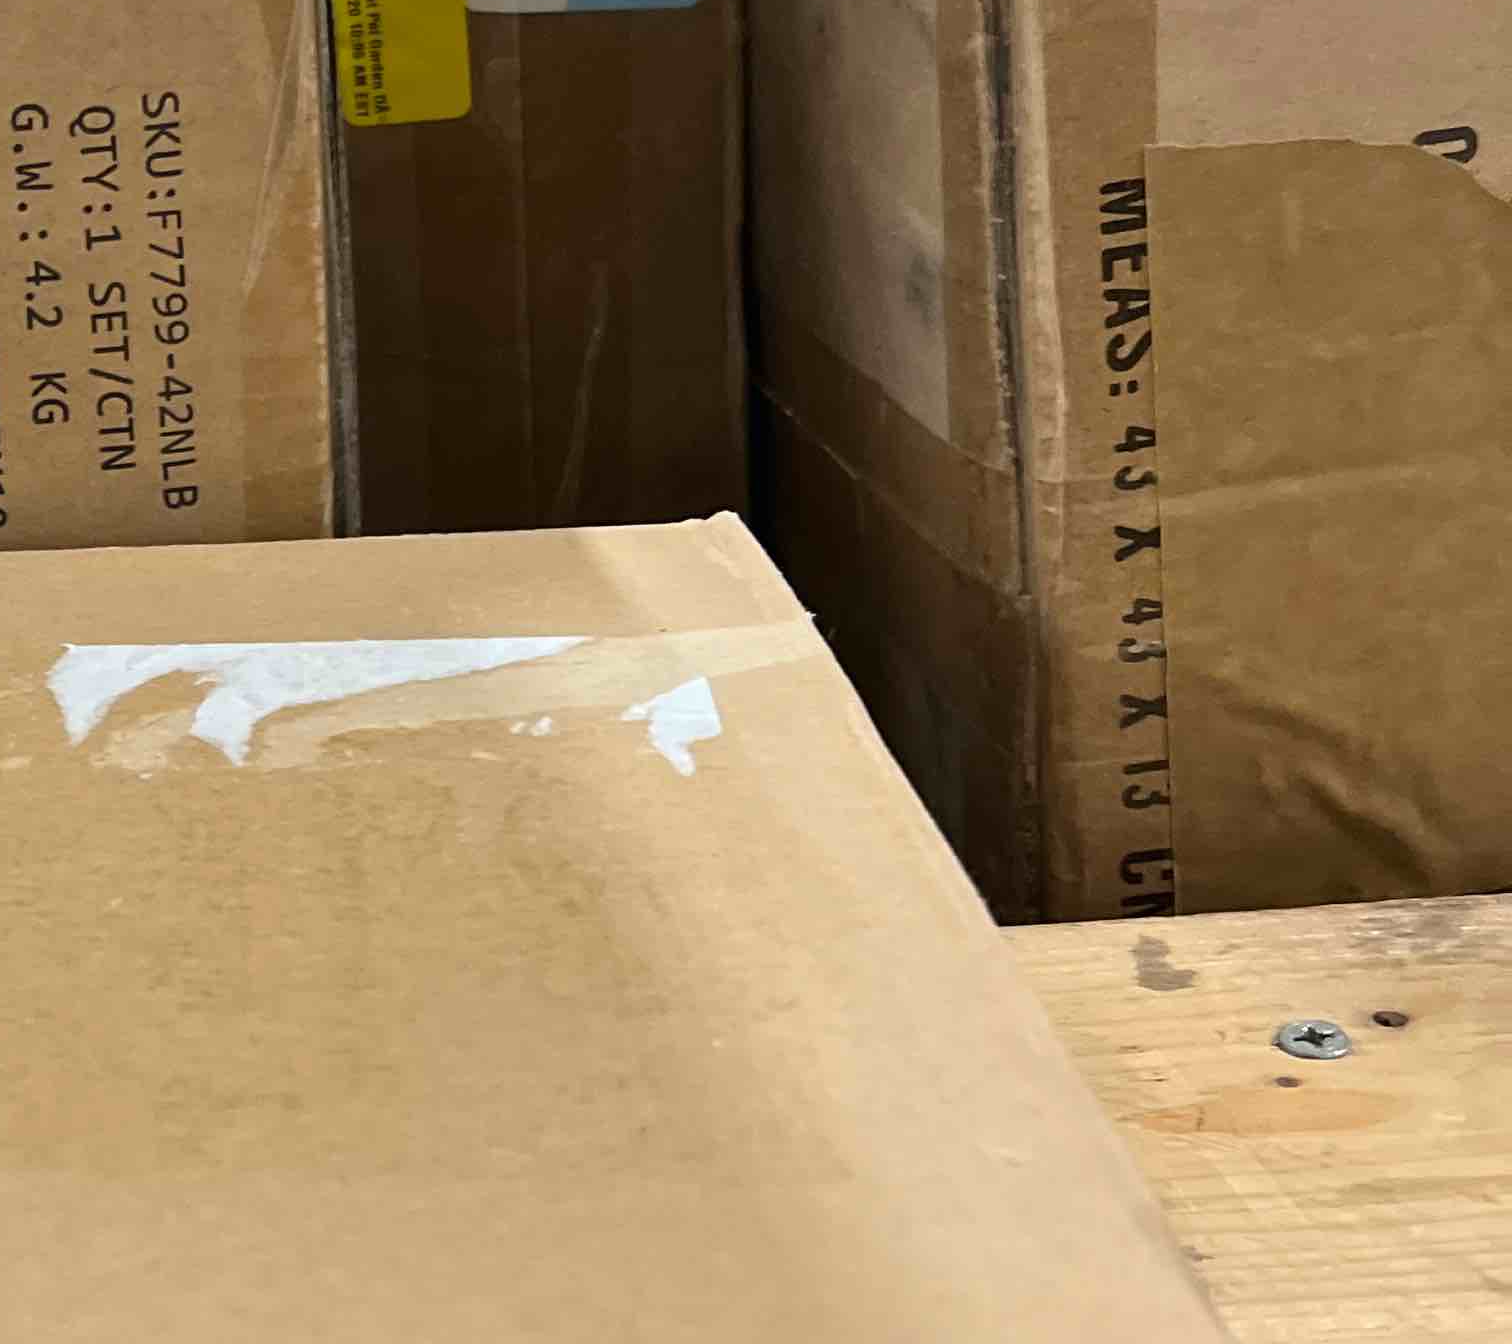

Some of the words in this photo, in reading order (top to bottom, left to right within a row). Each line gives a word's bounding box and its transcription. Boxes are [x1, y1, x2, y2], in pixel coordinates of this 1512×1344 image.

[68, 105, 122, 253] QTY:1
[23, 261, 64, 332] 4.2
[141, 91, 201, 512] SKU:F7799-42NLB
[1099, 178, 1152, 397] MEAS:
[28, 371, 71, 426] KG
[84, 281, 136, 473] SET/CTN
[1112, 526, 1161, 562] X
[1120, 695, 1167, 729] X
